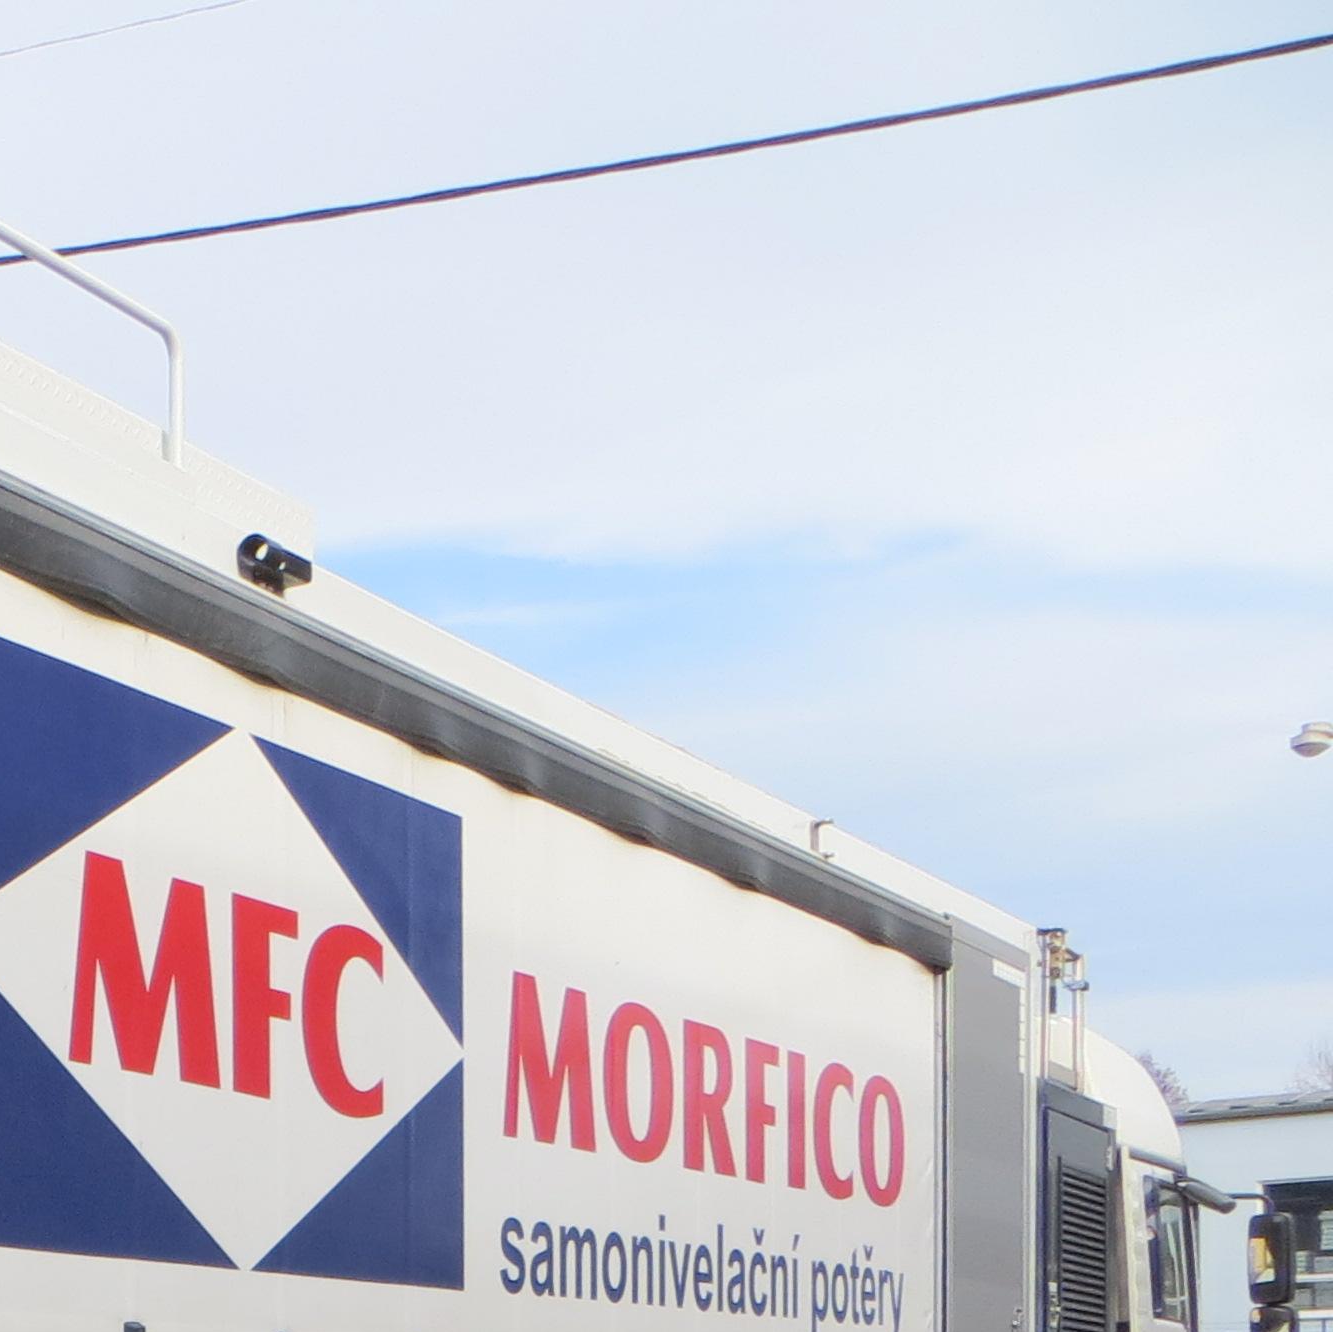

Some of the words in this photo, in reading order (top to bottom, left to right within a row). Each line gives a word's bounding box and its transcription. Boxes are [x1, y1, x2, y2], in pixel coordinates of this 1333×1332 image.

[69, 850, 384, 1118] MFC
[503, 970, 904, 1207] MORFICO
[499, 1214, 799, 1320] samonivelační
